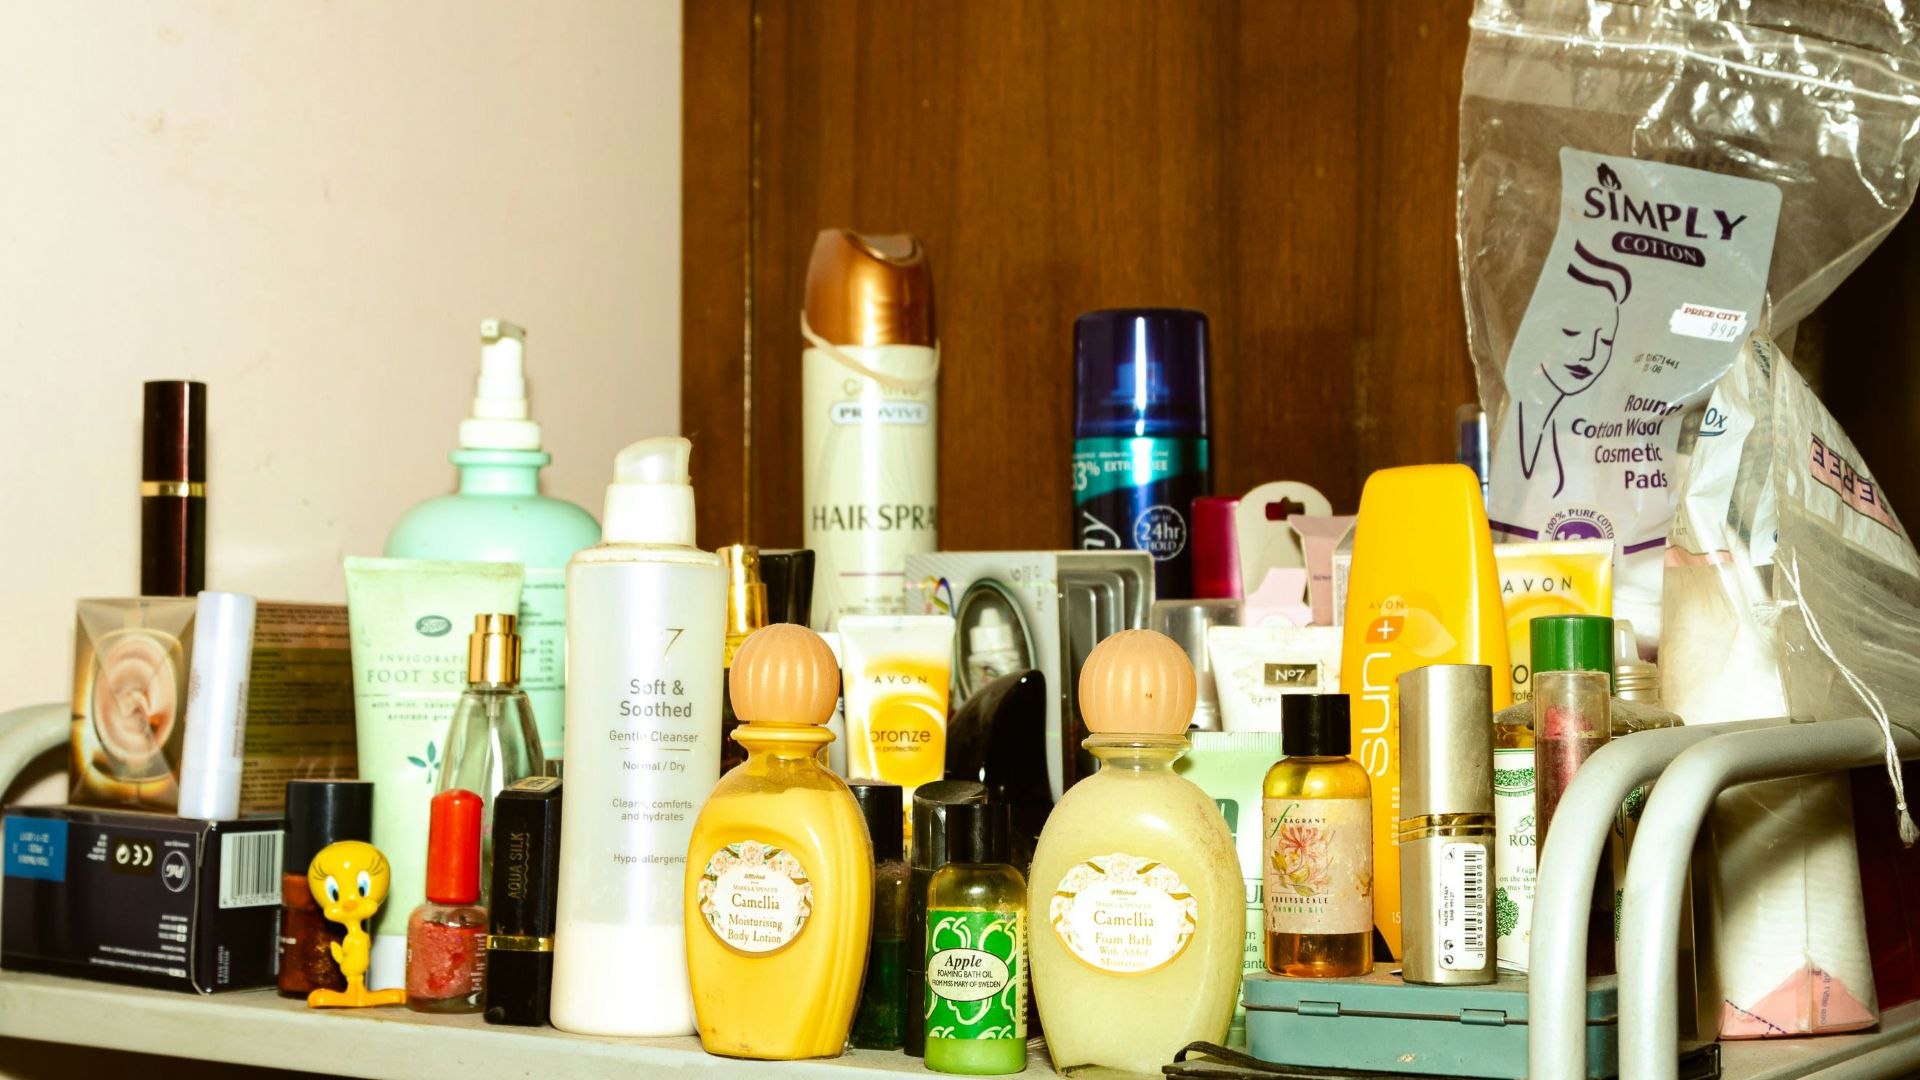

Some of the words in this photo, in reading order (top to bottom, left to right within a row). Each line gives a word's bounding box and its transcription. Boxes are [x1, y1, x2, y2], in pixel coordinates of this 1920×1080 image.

[1584, 187, 1748, 241] SIMPLY
[1619, 235, 1698, 263] COTTON
[1683, 306, 1716, 319] PRICE
[1715, 311, 1742, 321] CITY
[839, 407, 923, 418] PRVIVE
[1571, 418, 1623, 439] Cotton
[1626, 418, 1665, 437] Wool
[1594, 443, 1663, 464] Cosmetic
[1624, 469, 1668, 490] Pads
[811, 505, 874, 531] HAIR
[1545, 510, 1566, 535] 100%
[1568, 508, 1597, 520] PURE
[1596, 513, 1615, 540] COTTO
[1140, 521, 1181, 541] 24hr
[1502, 576, 1573, 594] AVON
[1368, 600, 1405, 610] AVON
[367, 670, 422, 683] FOOT
[873, 674, 929, 684] AVON
[629, 678, 667, 696] Soft
[672, 679, 685, 696] &
[619, 700, 693, 718] Soothed
[1360, 651, 1392, 778] sun
[609, 729, 647, 744] Gentl
[650, 730, 700, 745] Cleanser
[669, 761, 686, 774] Dry
[651, 799, 693, 809] comforts
[620, 812, 640, 821] and
[642, 812, 685, 823] hydrates
[509, 832, 524, 861] SILK
[507, 864, 522, 900] AQUA
[731, 892, 781, 910] Camellia
[728, 913, 783, 932] Moisturising
[1093, 910, 1155, 927] Camellia
[727, 928, 750, 945] Body
[752, 930, 782, 944] Lotion
[944, 954, 983, 970] Apple
[937, 969, 963, 978] FOAMING
[963, 970, 981, 979] BATH
[982, 970, 994, 979] OIL
[953, 980, 969, 988] MARY
[969, 980, 978, 988] OF
[978, 980, 1001, 988] SWEDEN
